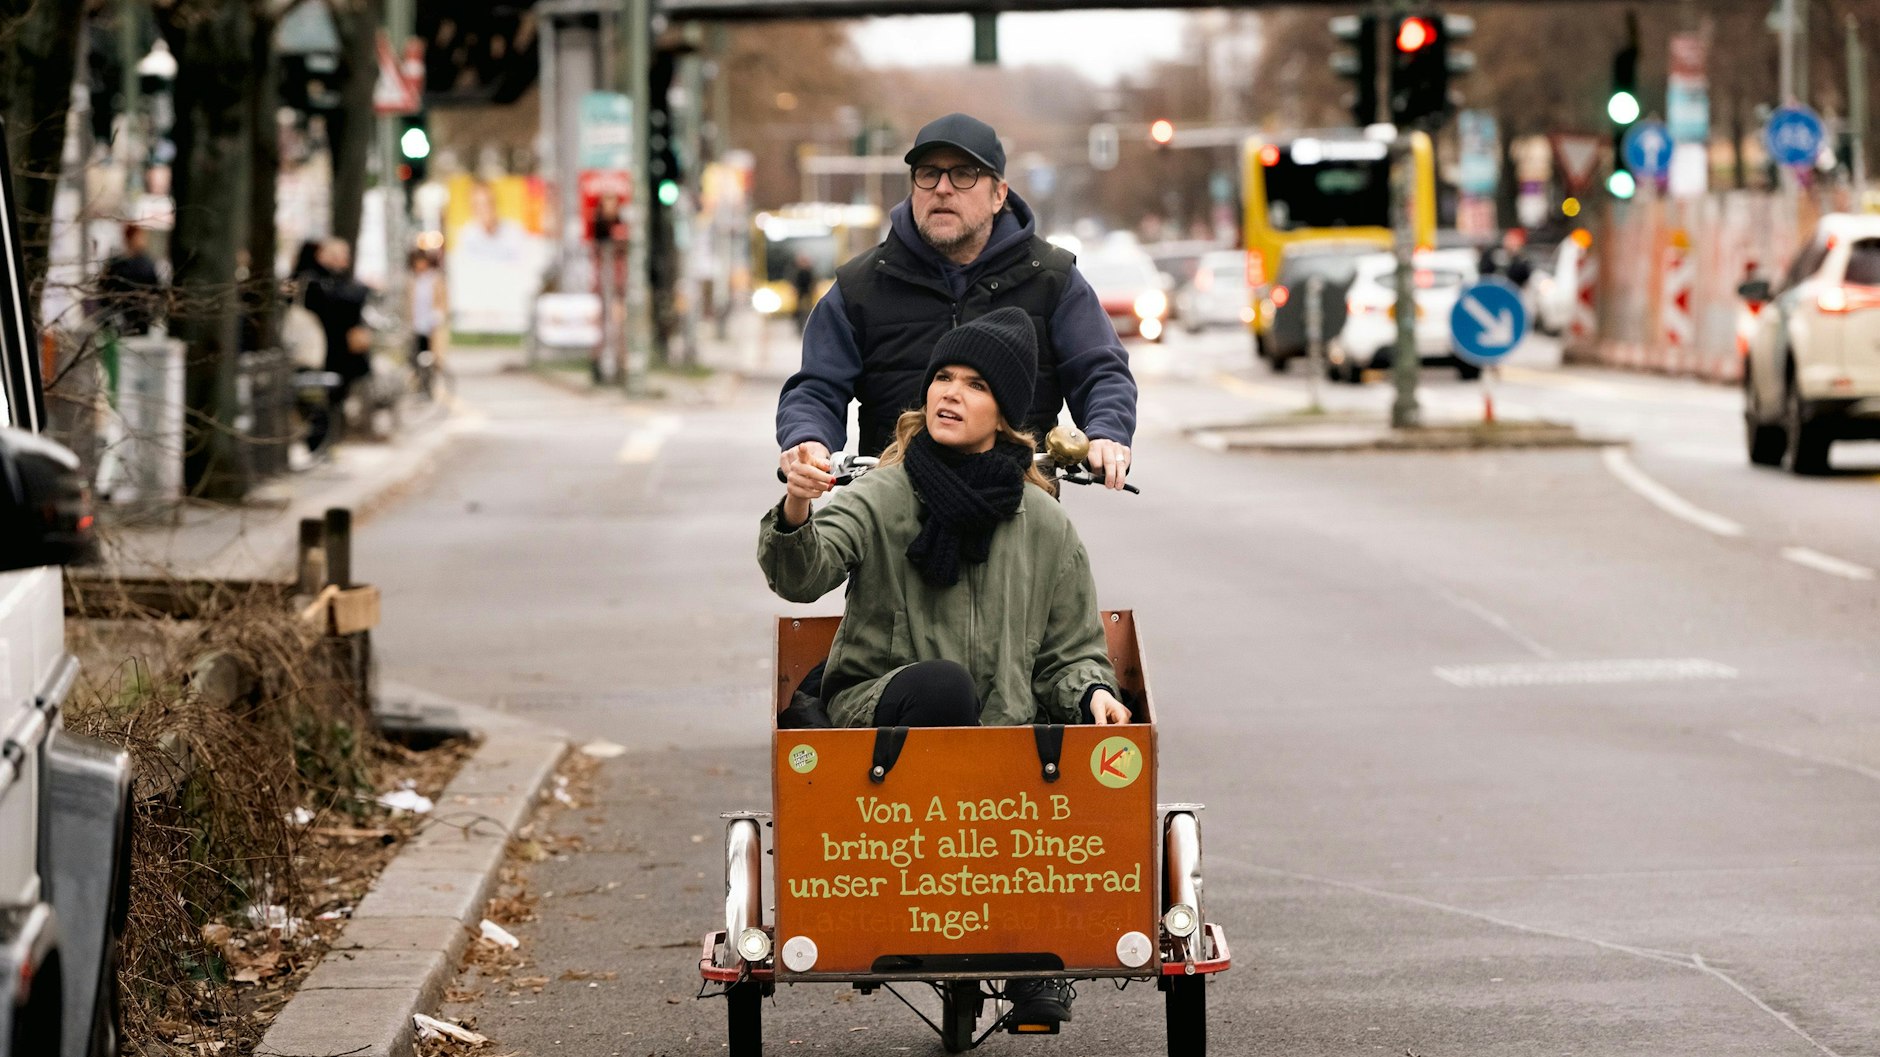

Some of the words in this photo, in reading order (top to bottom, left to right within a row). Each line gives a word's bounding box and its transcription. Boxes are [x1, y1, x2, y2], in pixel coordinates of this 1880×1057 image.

[856, 796, 913, 824] Von
[925, 796, 947, 822] A
[957, 792, 1039, 822] nach
[1050, 794, 1071, 821] B
[821, 828, 926, 868] bringt
[938, 829, 999, 859] alle
[1010, 828, 1106, 865] Dinge
[788, 874, 888, 899] unser
[899, 863, 1141, 897] Lastenfahrrad
[908, 903, 989, 940] Inge!
